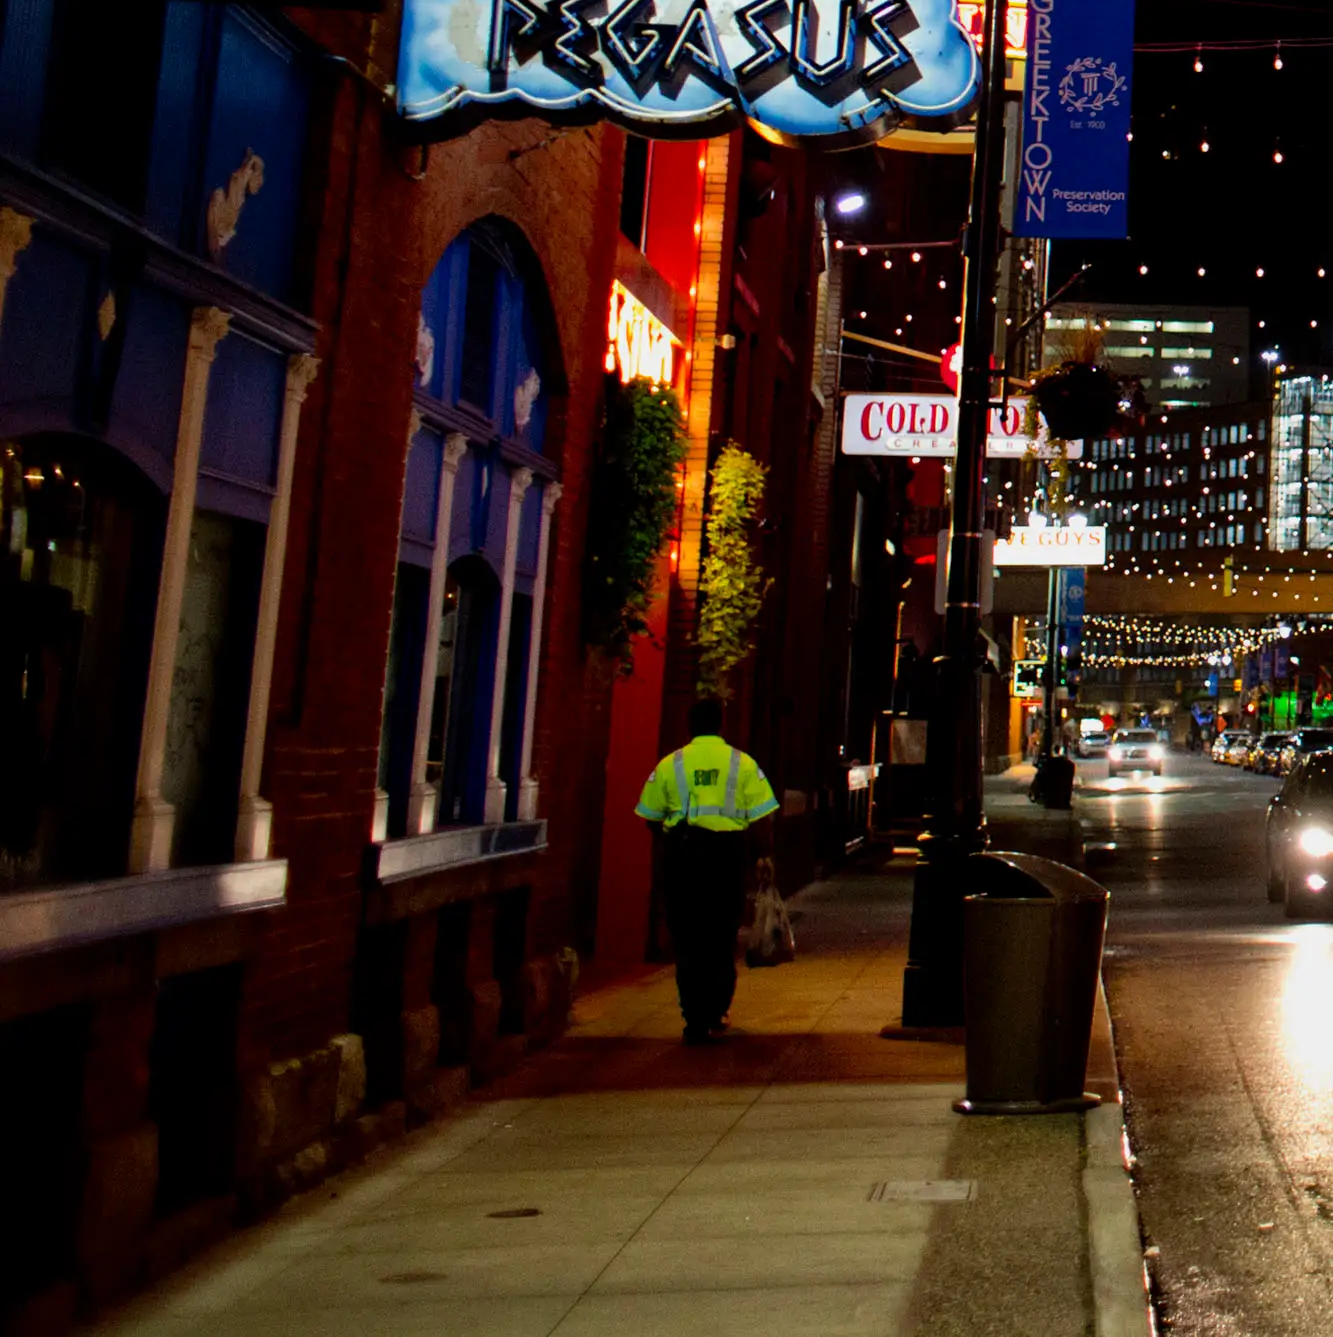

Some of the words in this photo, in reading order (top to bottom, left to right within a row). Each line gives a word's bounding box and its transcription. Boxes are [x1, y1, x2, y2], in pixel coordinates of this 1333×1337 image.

[1053, 188, 1126, 201] Preservation
[1066, 201, 1112, 215] Society
[860, 401, 950, 441] COLD
[1038, 531, 1102, 546] GUYS
